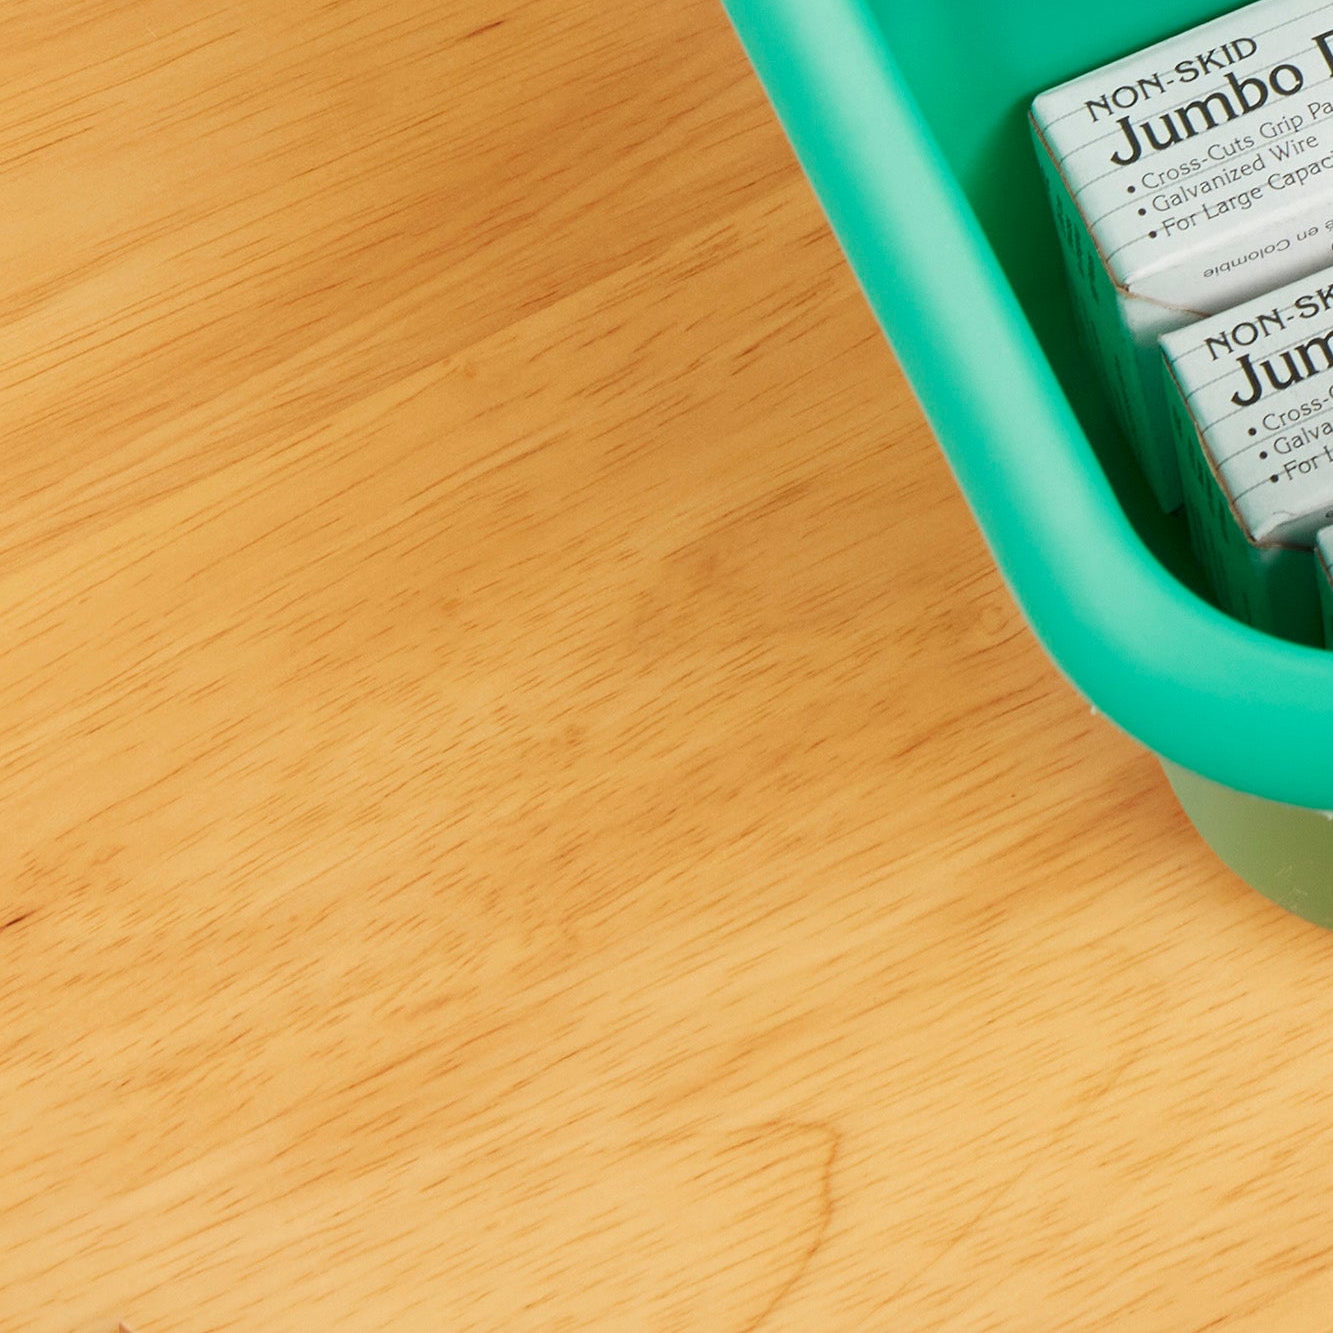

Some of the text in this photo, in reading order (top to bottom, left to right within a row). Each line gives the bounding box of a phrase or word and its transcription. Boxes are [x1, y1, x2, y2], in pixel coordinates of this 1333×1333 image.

[1084, 37, 1257, 122] NON-SKID
[1110, 64, 1304, 166] Jumbo
[1141, 135, 1255, 189] Cross-Cuts
[1259, 113, 1304, 139] Grip
[1152, 135, 1319, 212] Galvanized Wire
[1162, 212, 1197, 237] For
[1203, 186, 1263, 221] Large
[1297, 227, 1319, 242] en
[1203, 239, 1291, 279] Colombie
[1283, 455, 1320, 482] For
